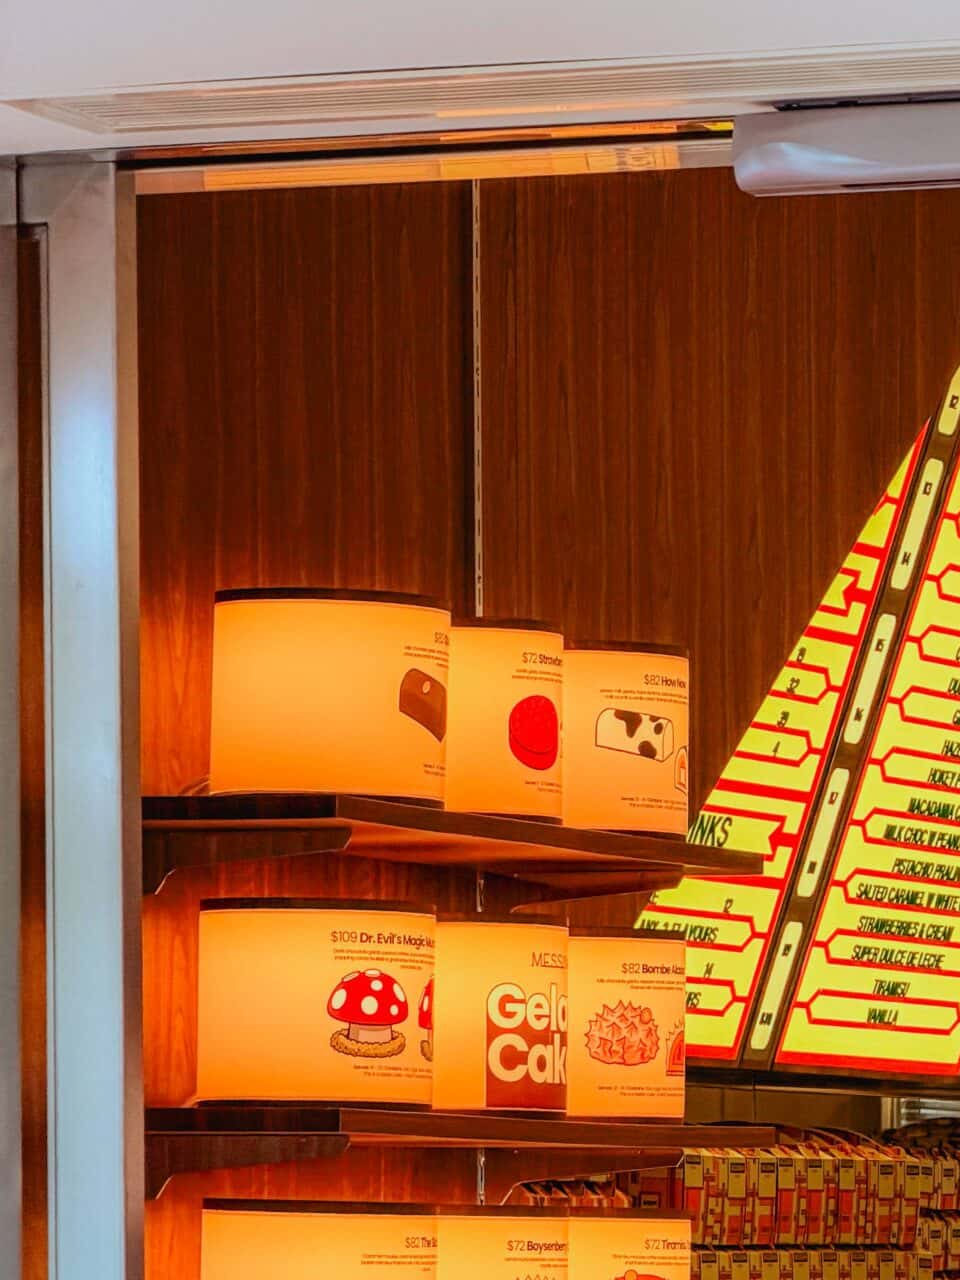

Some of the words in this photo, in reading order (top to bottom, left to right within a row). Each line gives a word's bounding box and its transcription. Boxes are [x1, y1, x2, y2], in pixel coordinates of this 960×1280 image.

[687, 813, 733, 848] INKS
[904, 828, 928, 845] CHOC
[331, 930, 357, 943] $109
[359, 931, 376, 944] Dr.
[621, 962, 640, 974] $82
[641, 963, 671, 975] Bombe
[506, 1240, 526, 1251] $72
[644, 1239, 660, 1250] $72
